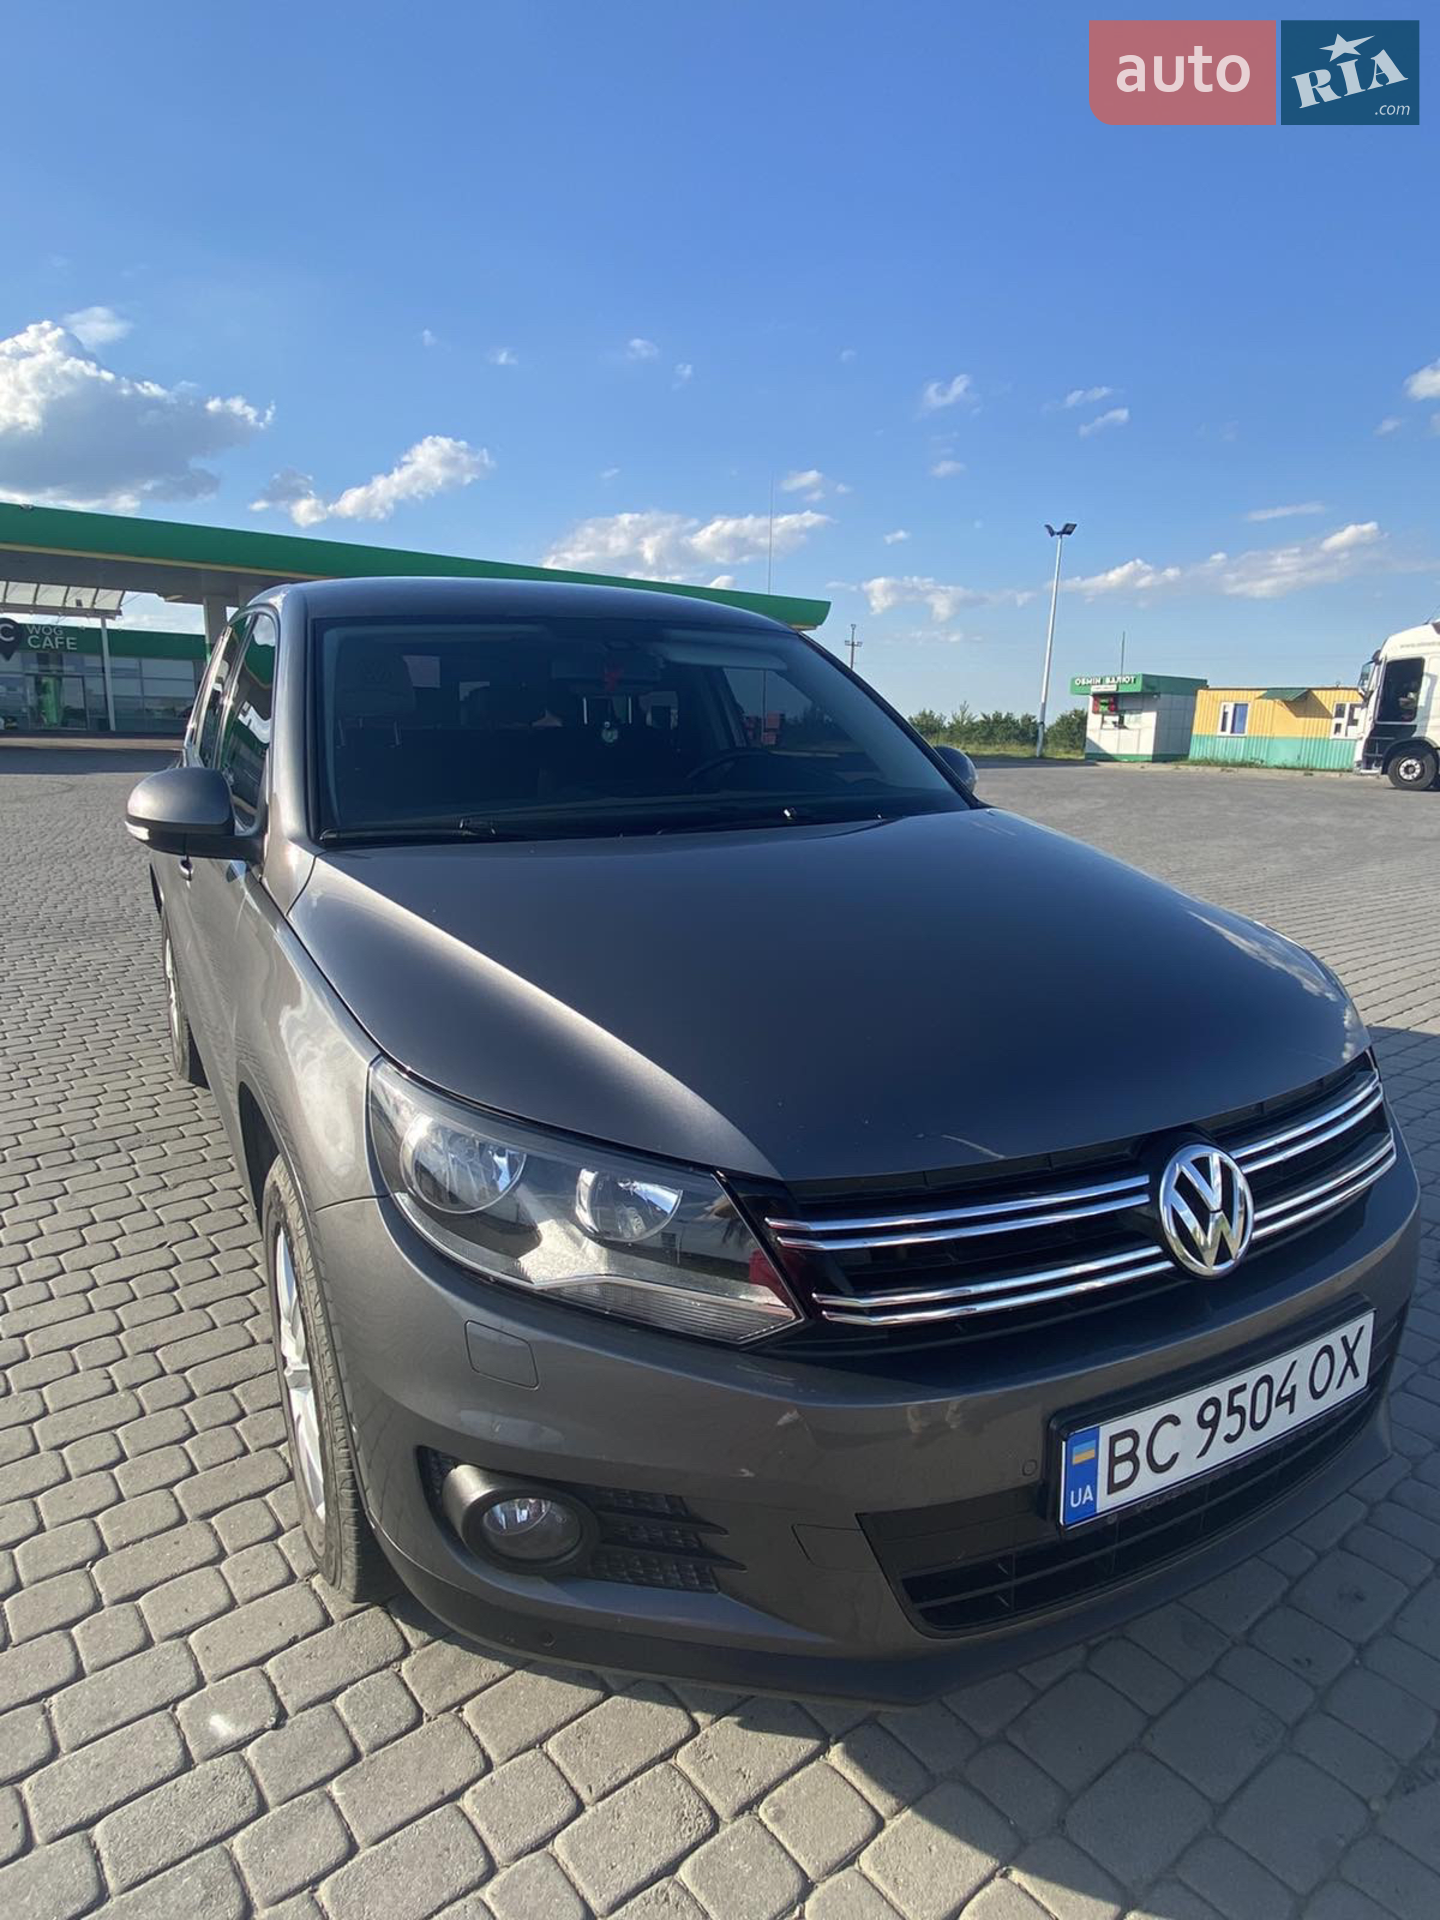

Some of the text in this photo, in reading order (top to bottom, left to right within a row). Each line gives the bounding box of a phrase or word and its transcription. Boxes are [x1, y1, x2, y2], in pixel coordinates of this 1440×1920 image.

[27, 624, 64, 636] WOG
[27, 635, 78, 650] CAFE
[1107, 1325, 1365, 1496] BC 9504 OX
[1069, 1484, 1094, 1508] UA
